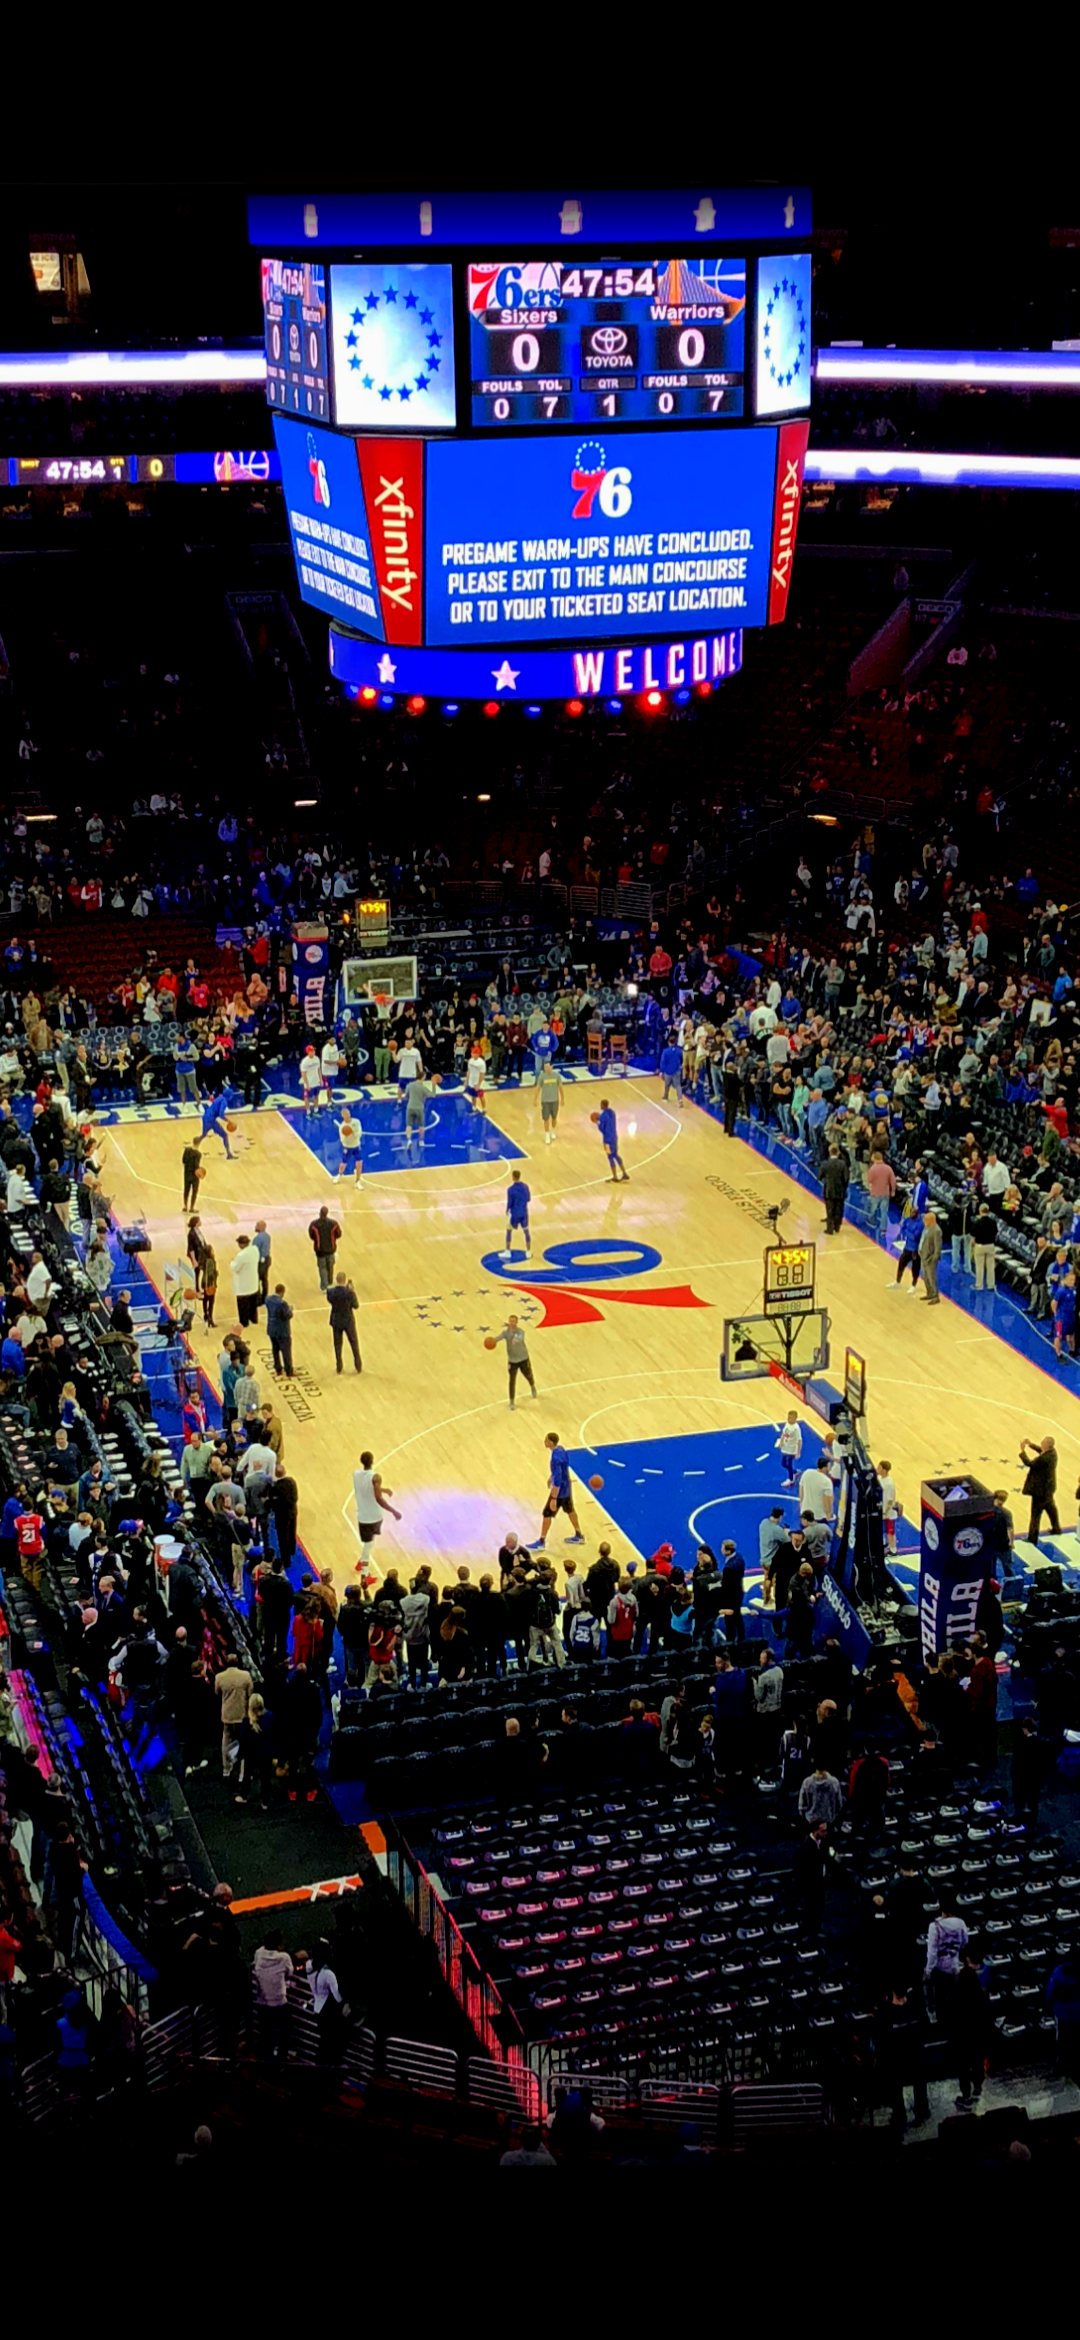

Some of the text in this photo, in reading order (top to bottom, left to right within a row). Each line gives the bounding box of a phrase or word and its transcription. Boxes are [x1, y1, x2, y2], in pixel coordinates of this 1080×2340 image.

[562, 268, 655, 297] 47:54
[501, 309, 558, 324] Sixers
[650, 304, 725, 321] Warriors
[273, 324, 280, 360] 0
[310, 332, 318, 368] 0
[512, 333, 539, 372] 0
[678, 329, 705, 367] 0
[586, 356, 633, 368] TOYOTA
[482, 380, 562, 392] FOULS TOL
[598, 379, 619, 389] QTR
[648, 374, 729, 388] FOULS TOL
[494, 397, 558, 419] 0 7
[603, 394, 615, 416] 1
[658, 391, 724, 413] 0 7
[46, 460, 105, 479] 47:54
[113, 466, 121, 479] 1
[150, 459, 163, 477] 0
[571, 466, 632, 518] 76
[772, 459, 799, 588] xfinity
[374, 475, 418, 611] xfinity
[442, 529, 754, 566] PREGAME WARM-UPS HAVE CONCLUDED.
[448, 558, 747, 595] PLEASE EXIT TO THE MAIN CONCOURSE
[451, 586, 747, 624] OR TO YOUR TICKETED SEAT LOCATION.
[573, 632, 735, 694] WELCOME
[278, 1384, 315, 1422] WELLS
[22, 1529, 36, 1542] 21
[790, 1747, 802, 1759] 21
